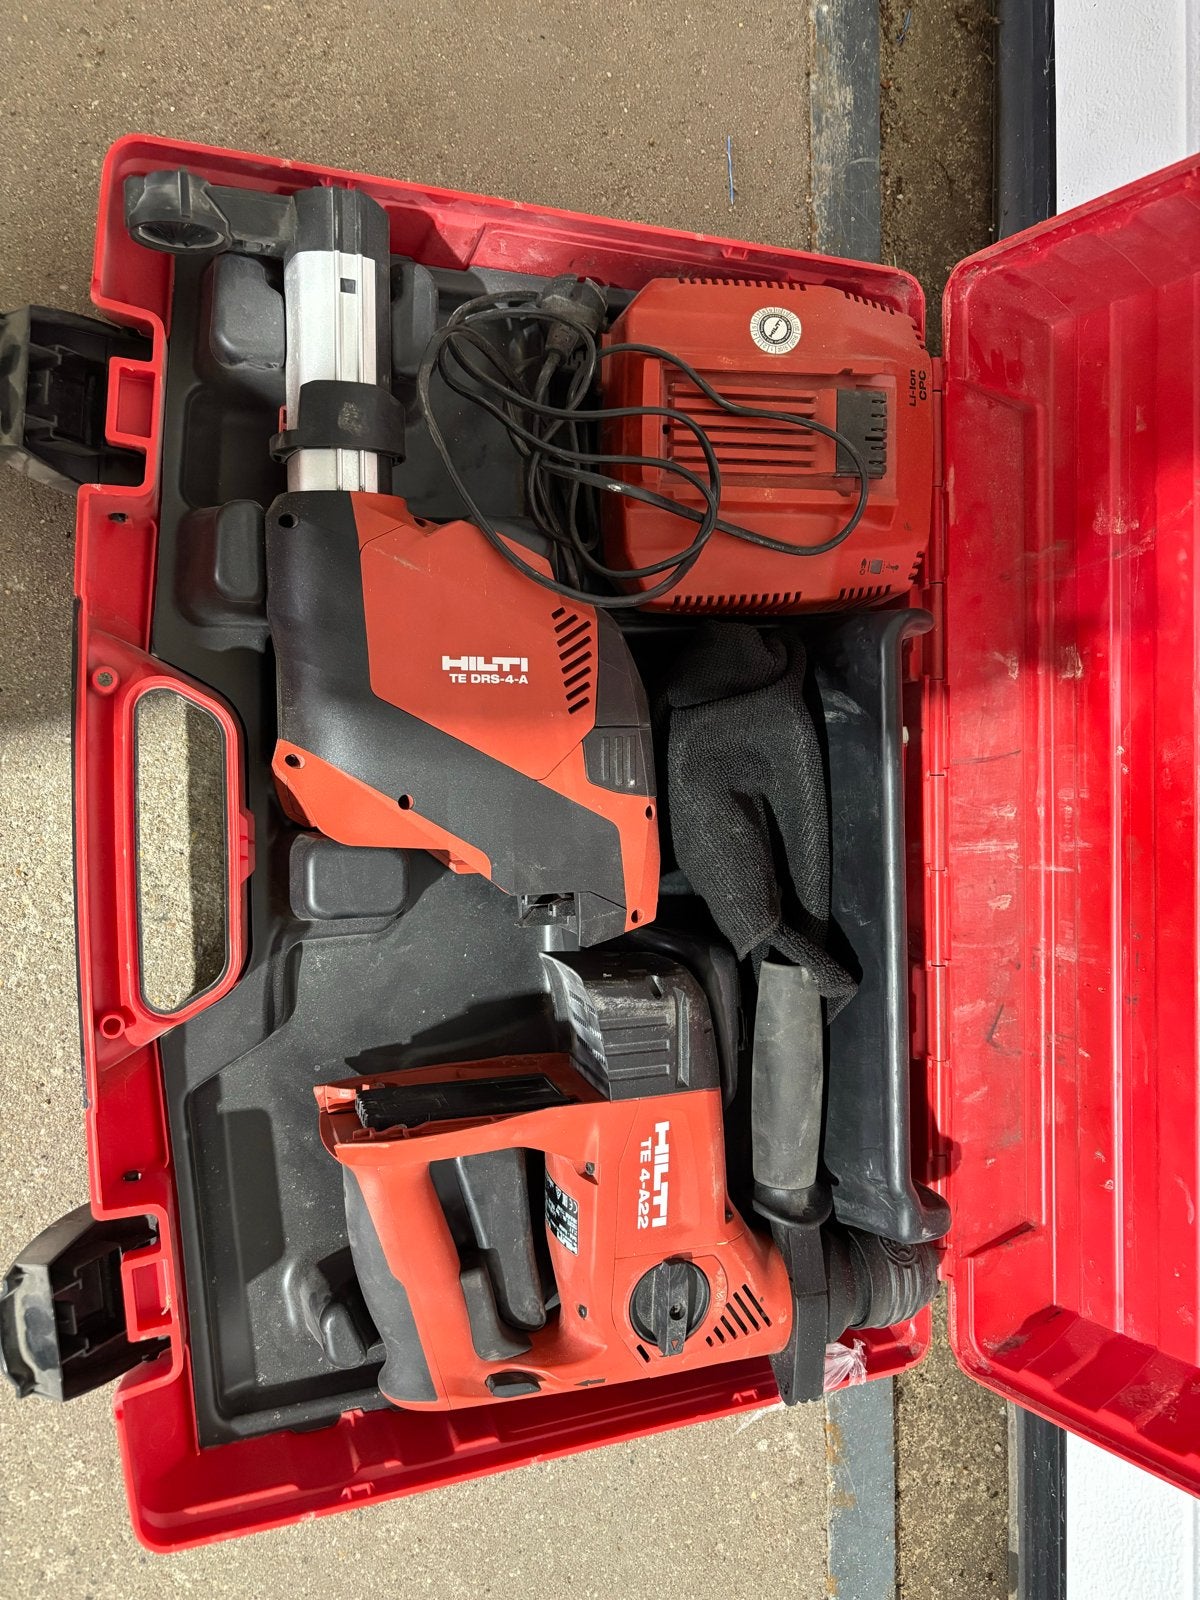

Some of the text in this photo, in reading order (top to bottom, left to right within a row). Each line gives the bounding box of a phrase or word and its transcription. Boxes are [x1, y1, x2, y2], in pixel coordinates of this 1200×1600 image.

[918, 370, 927, 401] CPC
[442, 655, 529, 672] HILTI
[449, 673, 529, 685] TE DRS-4-A
[637, 1136, 652, 1230] TE 4-A22
[652, 1120, 670, 1228] HILTI
